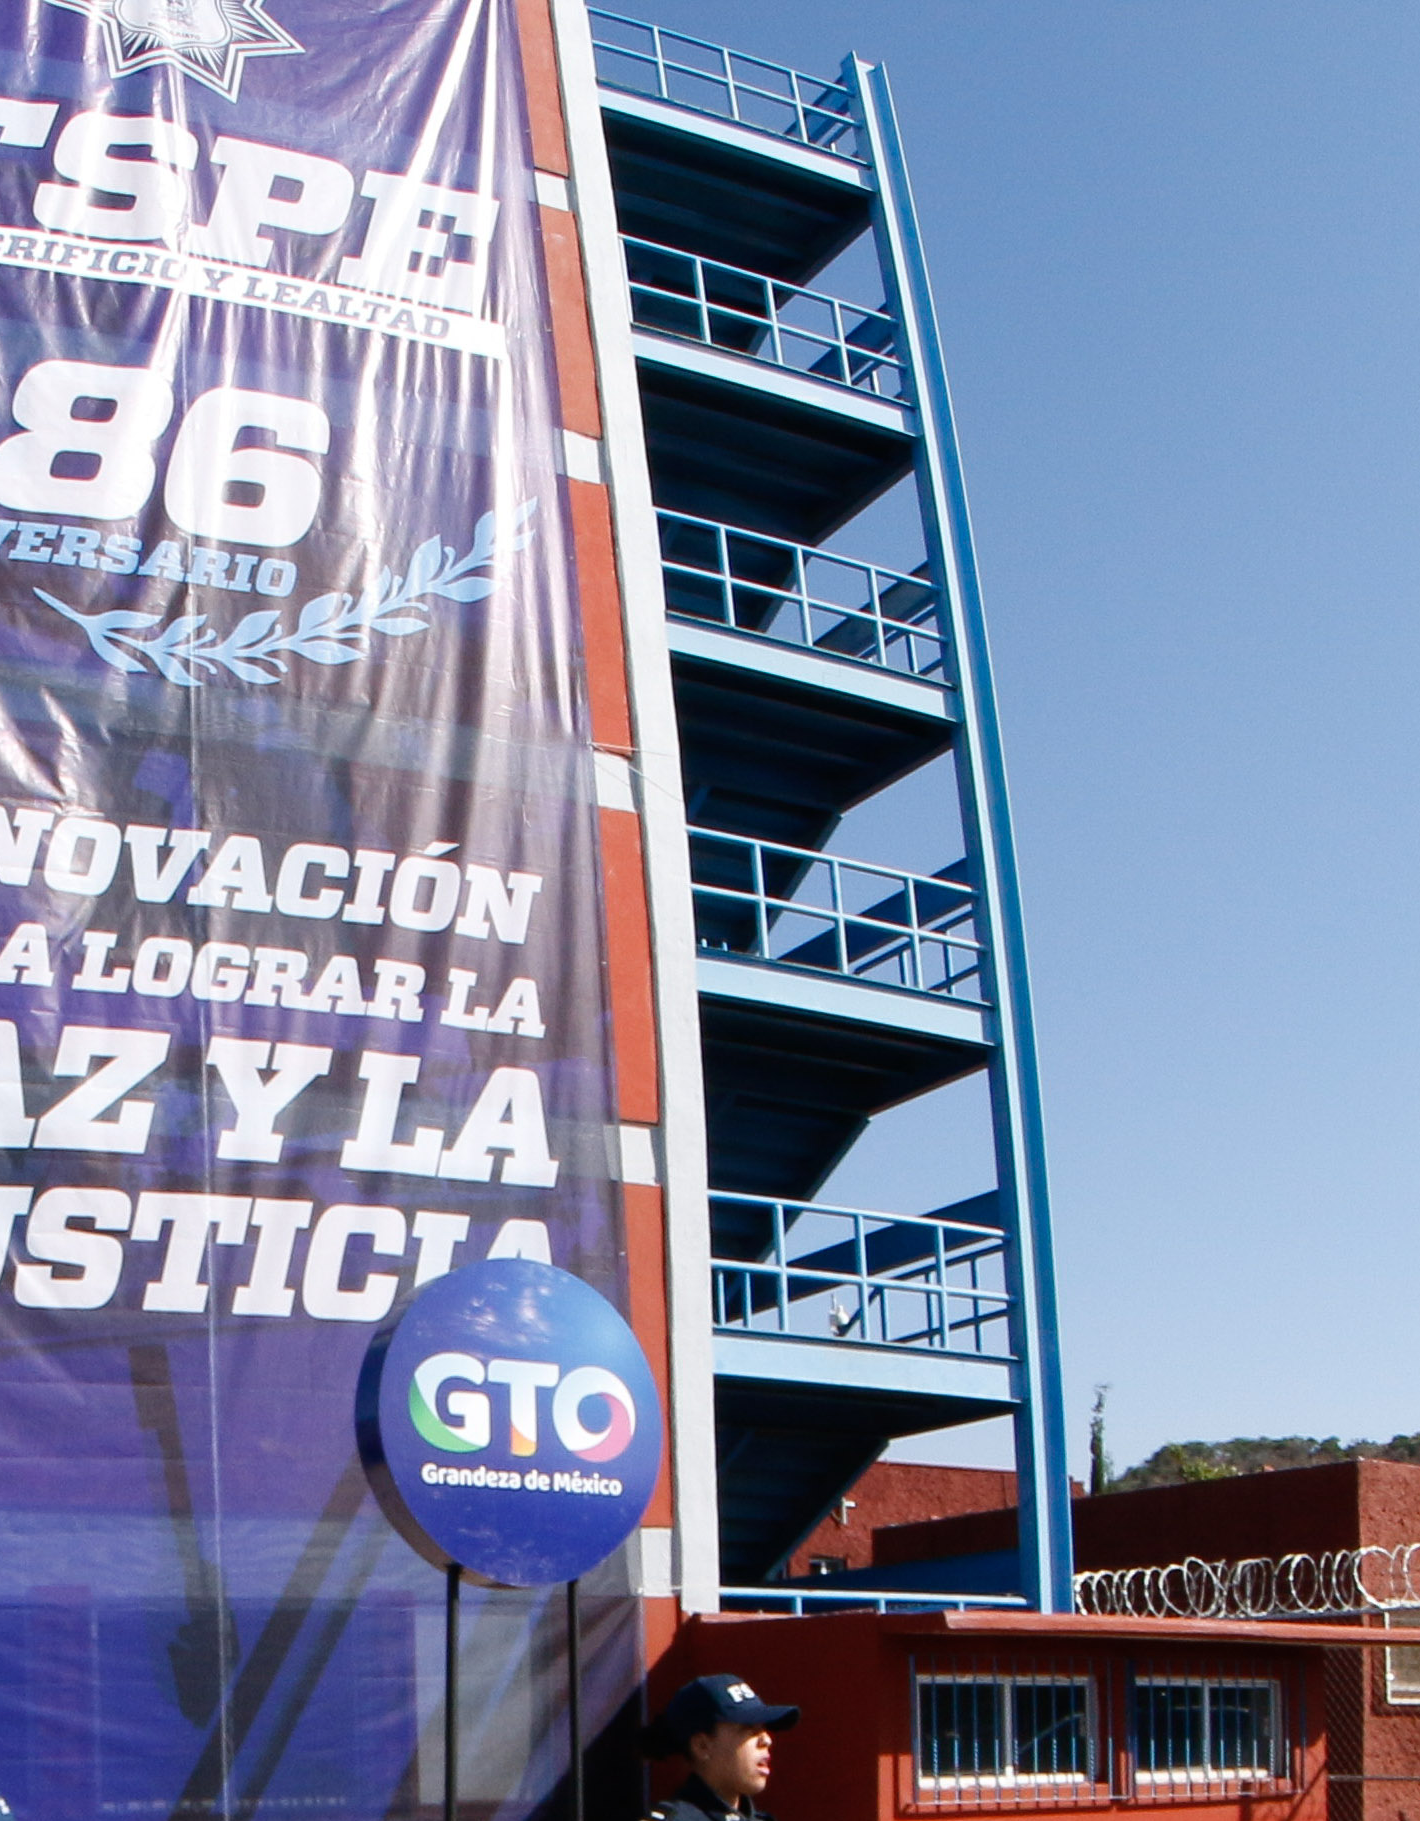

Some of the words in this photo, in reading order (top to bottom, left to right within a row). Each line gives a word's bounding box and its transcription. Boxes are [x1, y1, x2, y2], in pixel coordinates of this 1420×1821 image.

[204, 267, 233, 293] Y
[243, 275, 451, 340] LEALTAD
[73, 931, 428, 1023] LOGRAR
[440, 968, 546, 1039] LA
[206, 1037, 332, 1163] Y
[340, 1050, 559, 1188] LA
[408, 1352, 636, 1463] GTO
[421, 1463, 522, 1490] Grandeza
[523, 1469, 551, 1491] de
[553, 1471, 623, 1496] México
